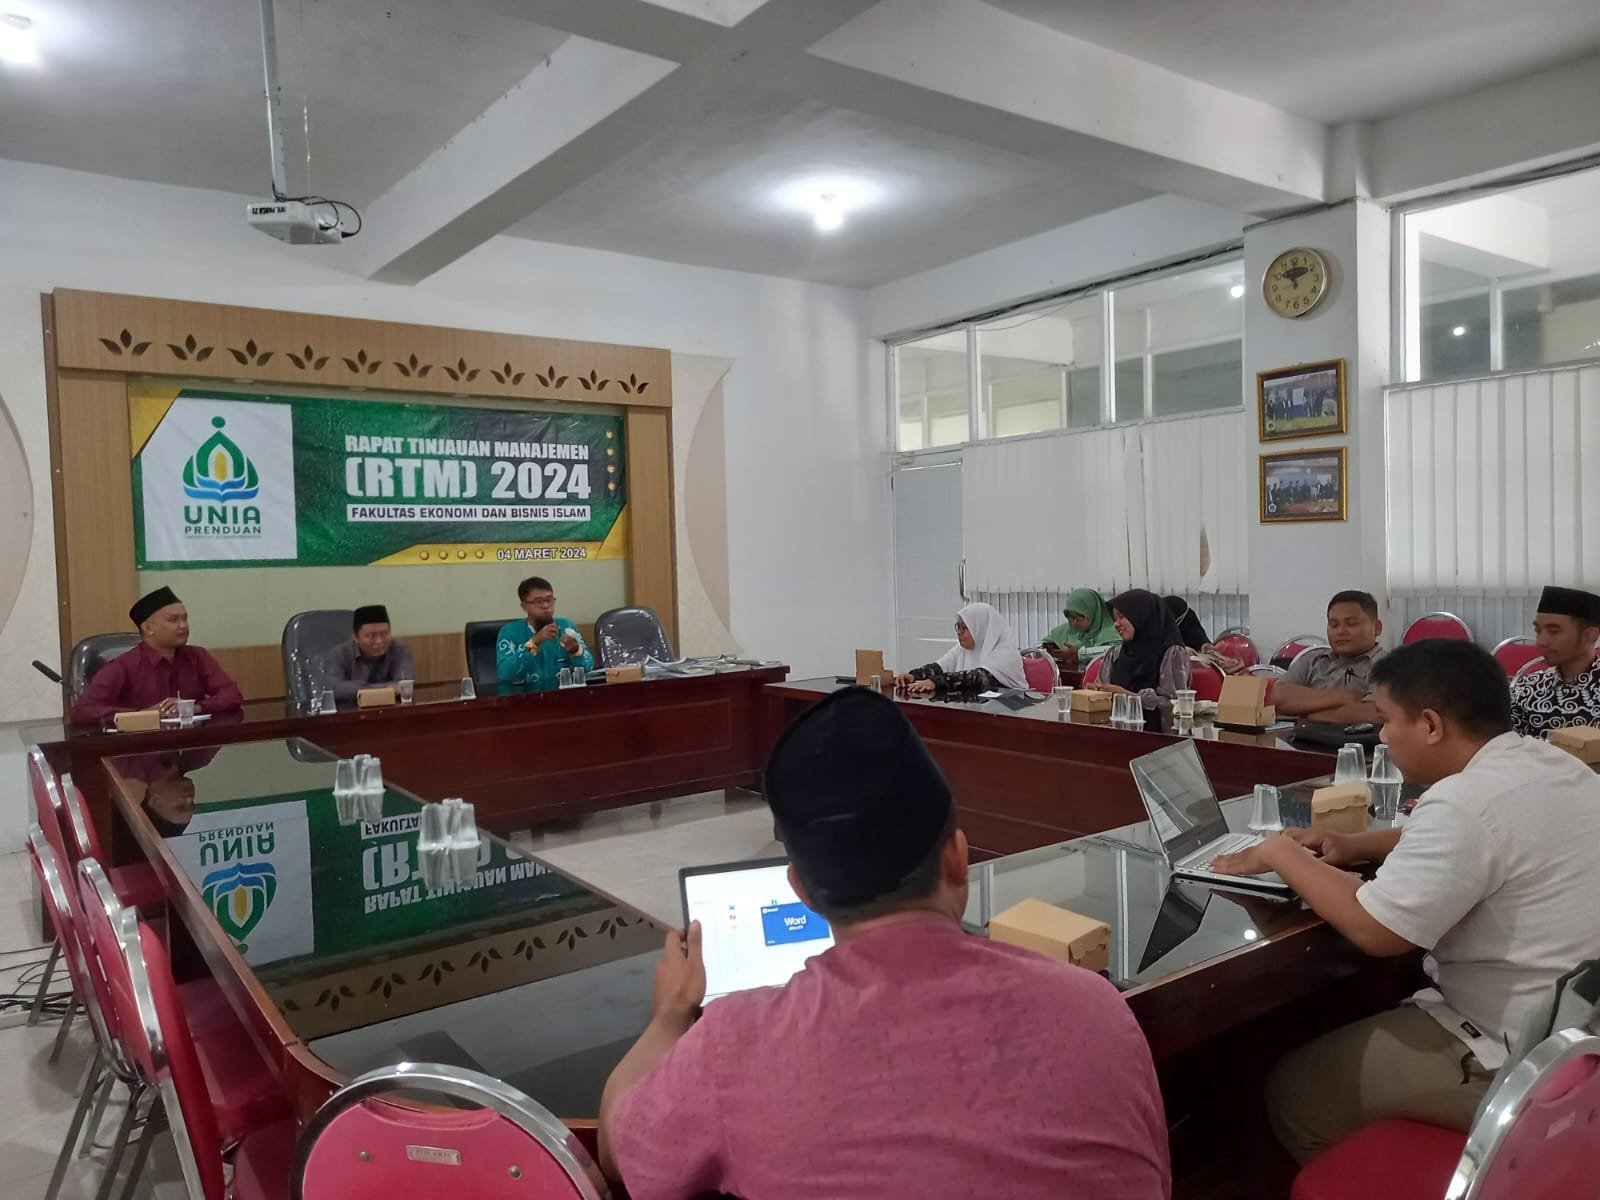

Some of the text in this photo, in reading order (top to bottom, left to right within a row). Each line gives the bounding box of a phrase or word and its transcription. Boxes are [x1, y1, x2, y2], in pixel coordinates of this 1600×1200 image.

[345, 434, 589, 460] RAPAT TINJAUAN MANAJEMEN
[345, 456, 591, 499] (RTM) 2024
[184, 505, 261, 525] UNIA
[352, 507, 586, 518] FAKULTAS EKONOMI DAN BISNIS ISLAM
[184, 525, 262, 535] PRENDUAN
[497, 547, 586, 560] 04 MARET 2024
[783, 914, 807, 926] Word
